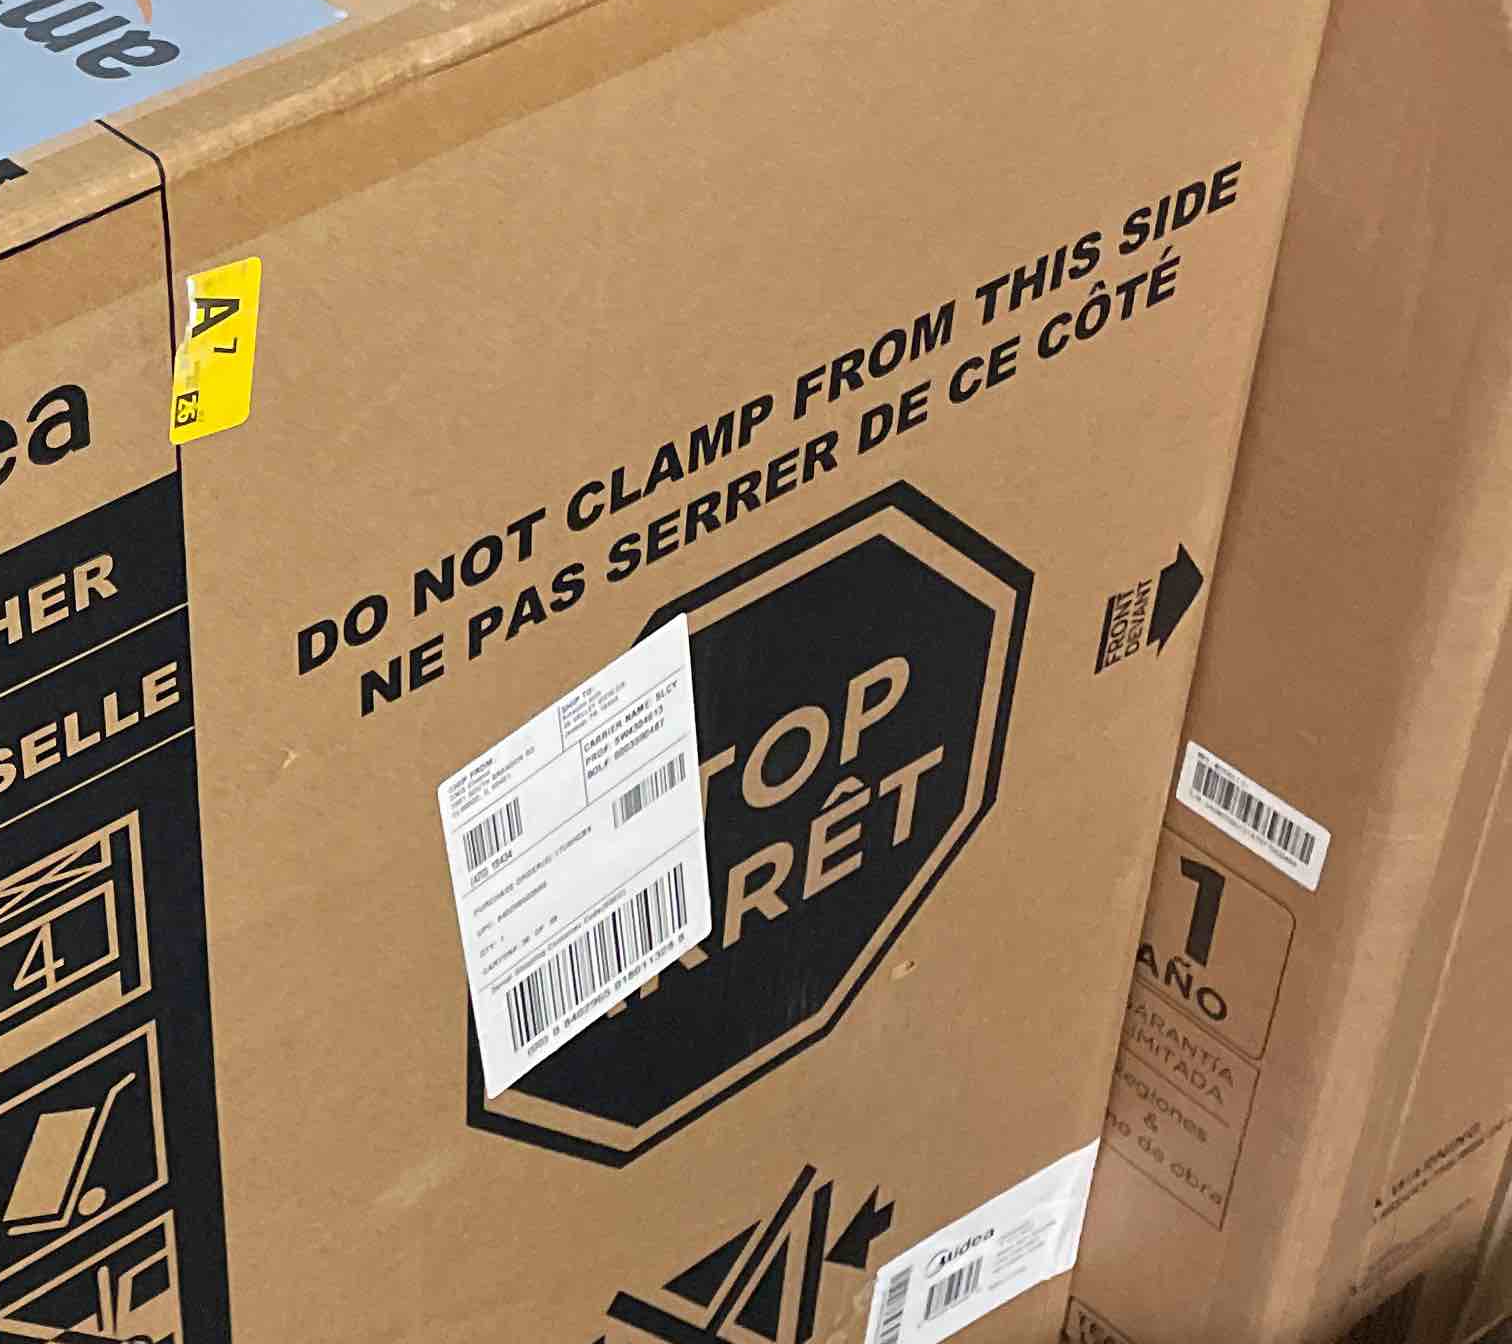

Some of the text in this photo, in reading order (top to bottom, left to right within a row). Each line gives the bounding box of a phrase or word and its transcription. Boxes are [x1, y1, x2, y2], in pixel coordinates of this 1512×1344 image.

[191, 297, 240, 339] A
[296, 161, 1245, 676] DO NOT CLAMP FROM THIS SIDE
[358, 249, 1185, 718] NE PAS SERRER DE CE CÔTÉ
[696, 656, 911, 830] TOP
[1181, 856, 1226, 967] 1
[1137, 942, 1228, 1022] AÑO
[1127, 1025, 1224, 1105] IMITADA
[1128, 1002, 1235, 1089] ARANTÍA
